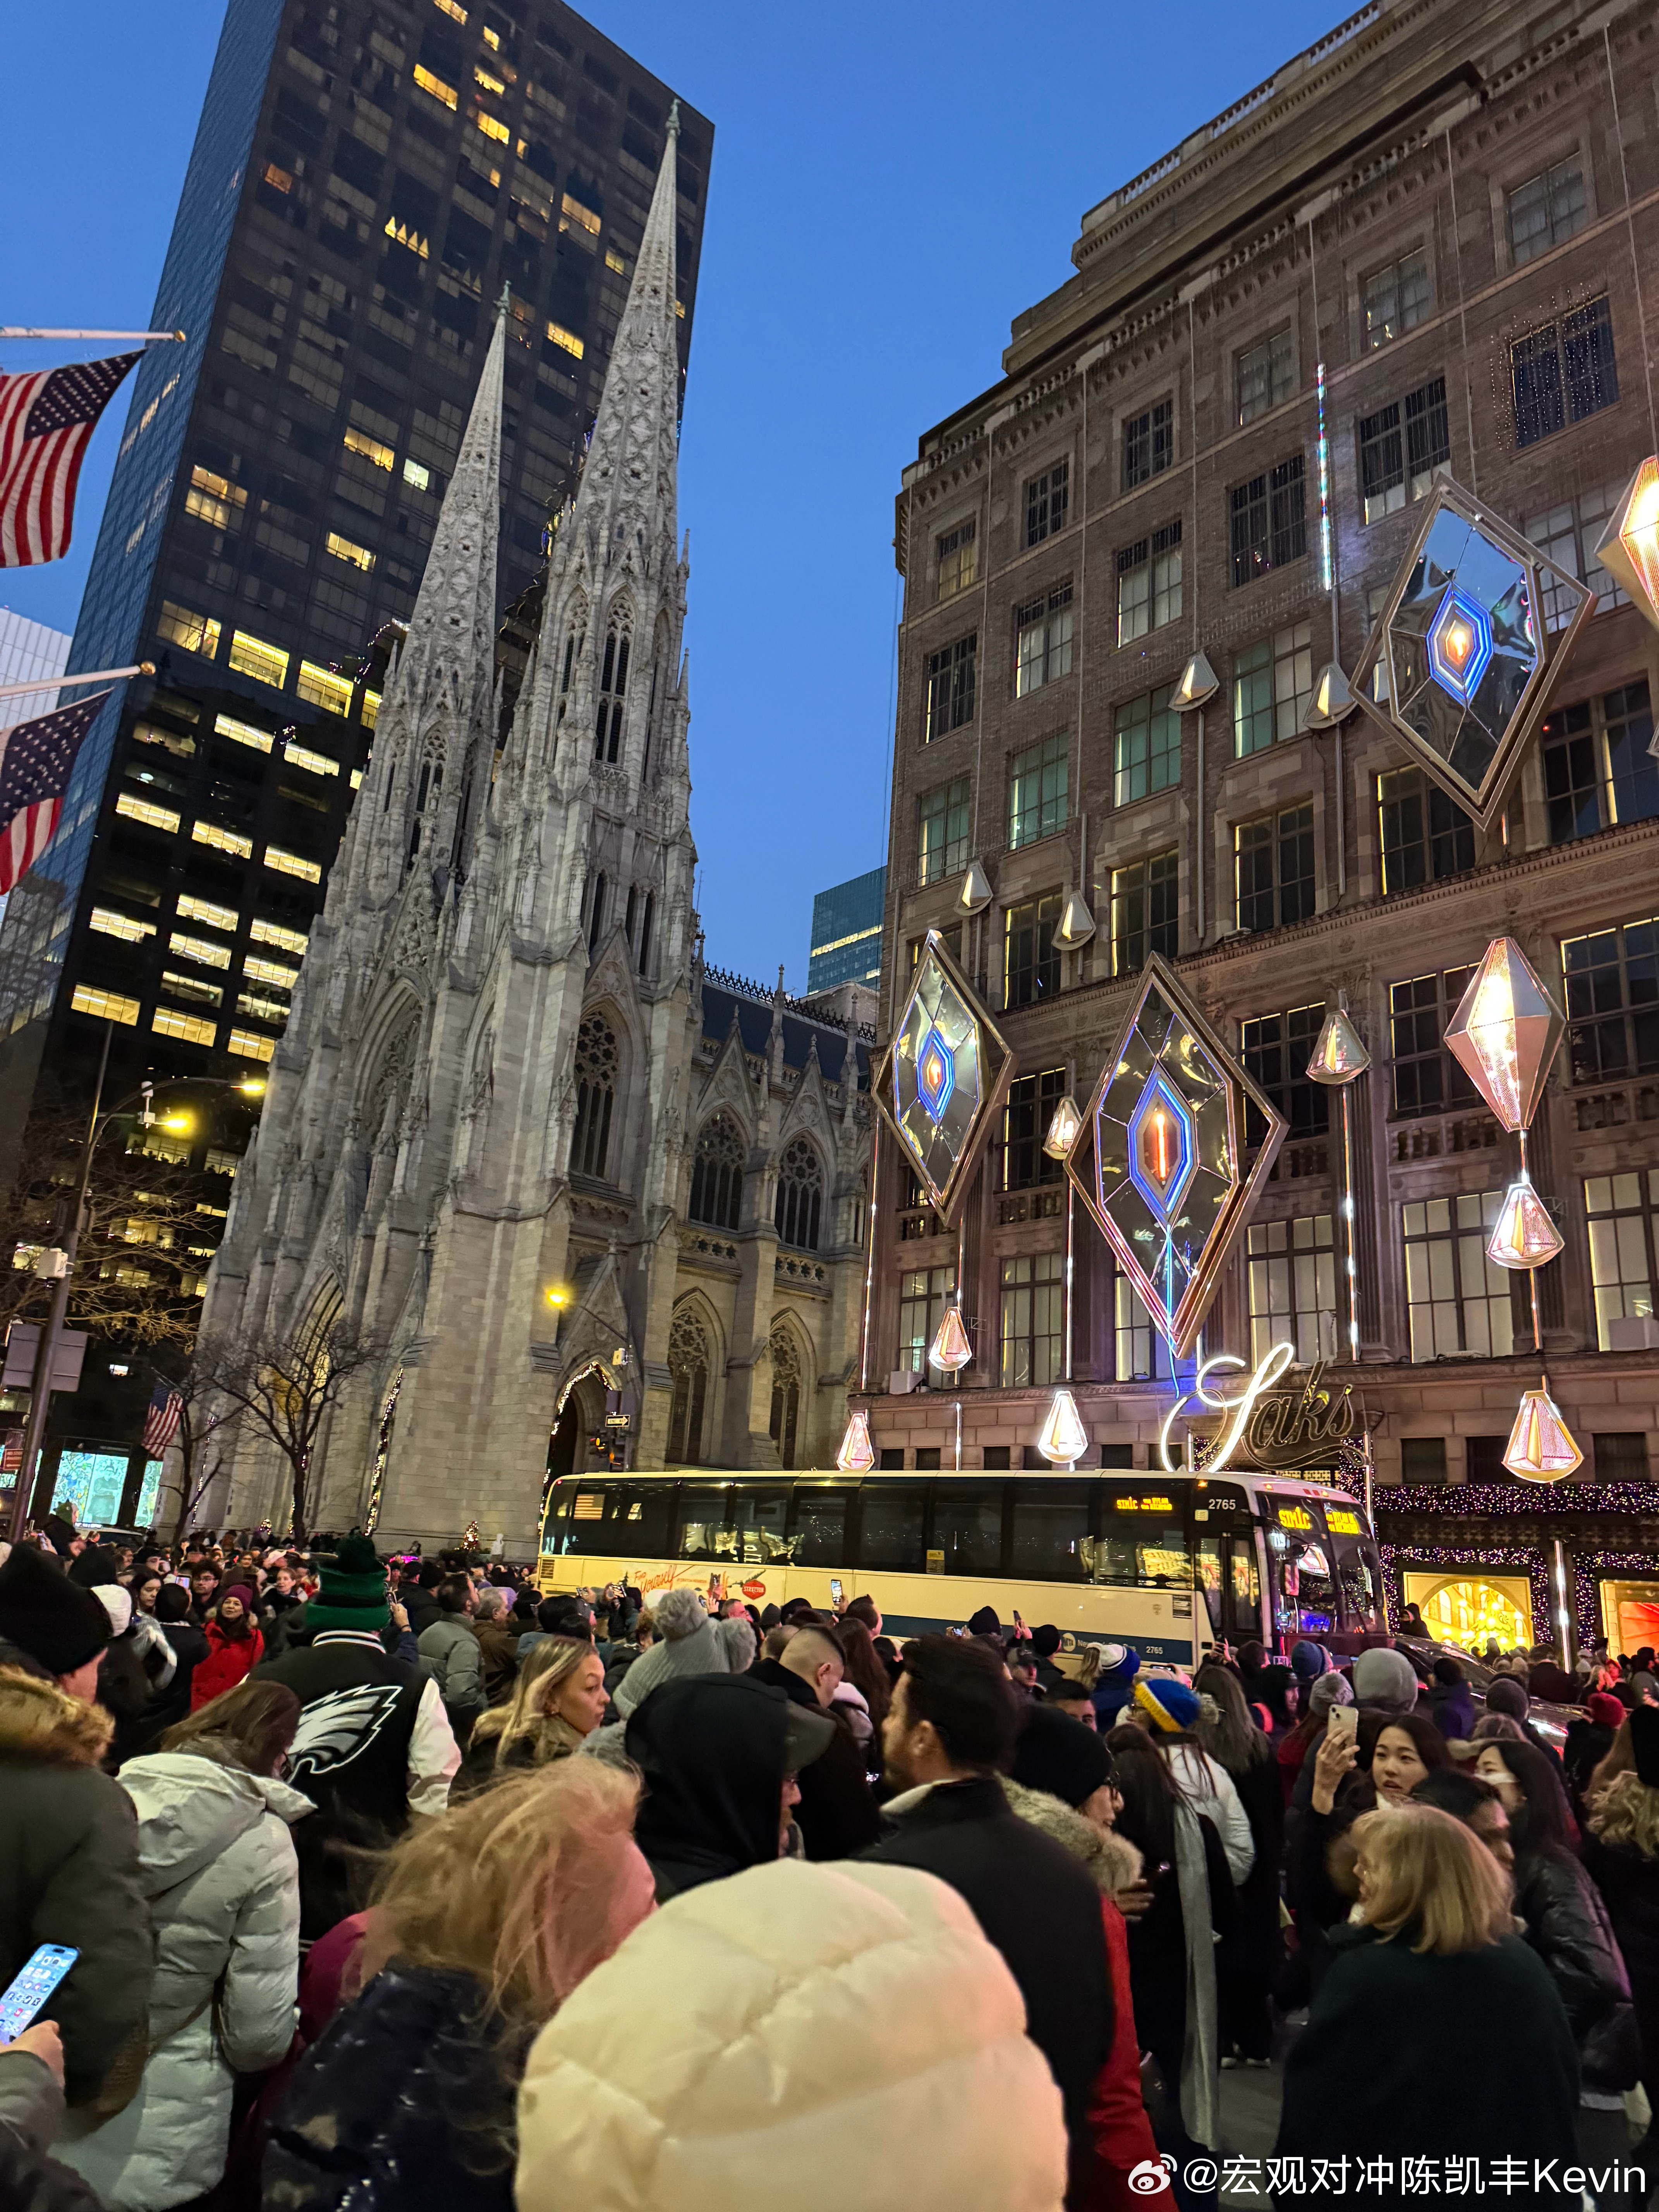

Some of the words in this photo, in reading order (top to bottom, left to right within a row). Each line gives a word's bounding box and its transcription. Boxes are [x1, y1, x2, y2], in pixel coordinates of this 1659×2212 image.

[1161, 1342, 1366, 1472] Saks
[1117, 1496, 1138, 1510] SIM1C
[1208, 1499, 1236, 1510] 2765
[1278, 1506, 1311, 1530] SIM1C
[1146, 1646, 1163, 1654] 2765
